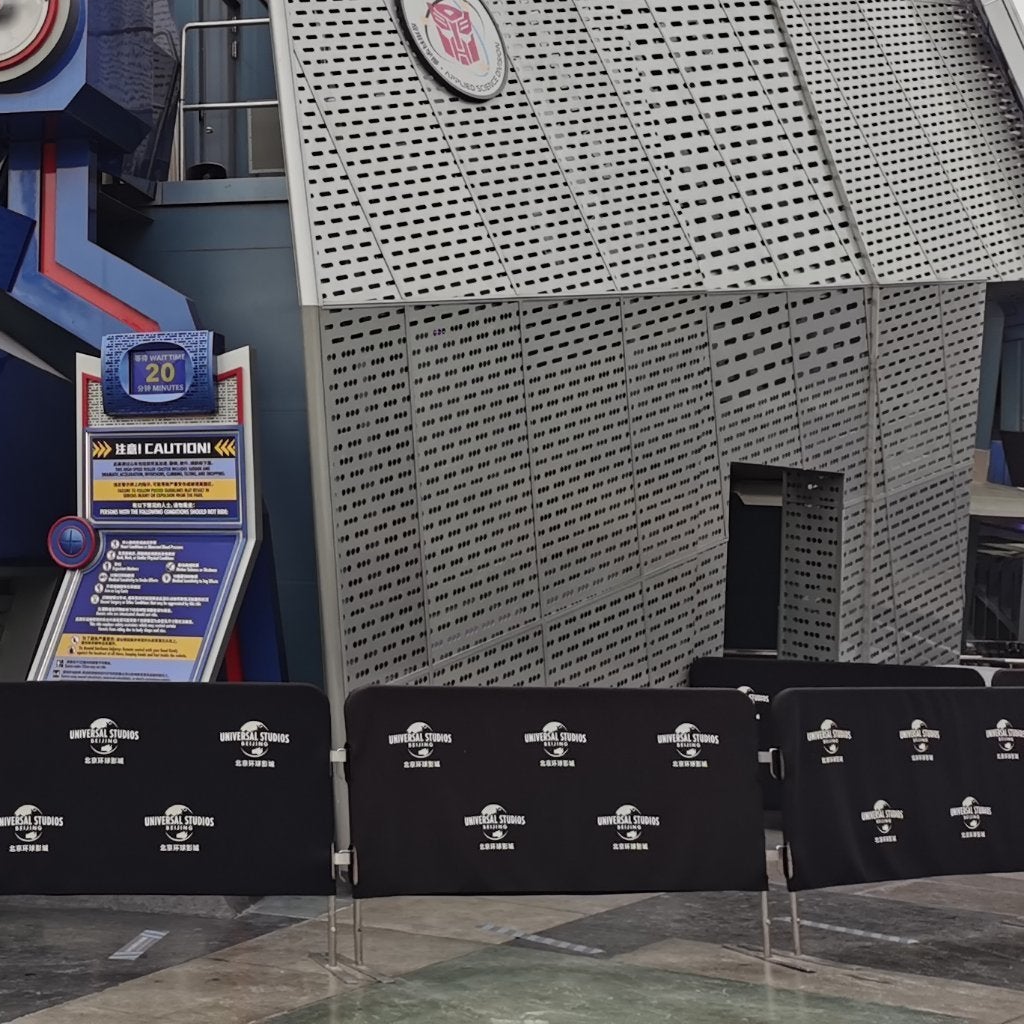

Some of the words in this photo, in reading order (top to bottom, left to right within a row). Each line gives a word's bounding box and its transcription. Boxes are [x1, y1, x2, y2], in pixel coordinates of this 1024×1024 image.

[146, 362, 174, 382] 20
[152, 384, 184, 392] MINUTES
[144, 442, 211, 454] CAUTION!
[69, 729, 108, 740] UNIVERSAL
[109, 729, 139, 741] STUDIOS
[220, 732, 258, 742] UNIVERSAL
[259, 732, 290, 744] STUDIOS
[389, 733, 424, 744] UNIVERSAL
[425, 733, 452, 744] STUDIOS
[524, 732, 559, 743] UNIVERSAL
[560, 732, 587, 743] STUDIOS
[657, 733, 692, 744] UNIVERSAL
[693, 733, 719, 745] STUDIOS
[34, 816, 63, 827] STUDIOS
[144, 816, 182, 827] UNIVERSAL
[184, 815, 214, 827] STUDIOS
[464, 815, 499, 826] UNIVERSAL
[499, 815, 526, 826] STUDIOS
[597, 816, 632, 826] UNIVERSAL
[633, 816, 660, 826] STUDIOS
